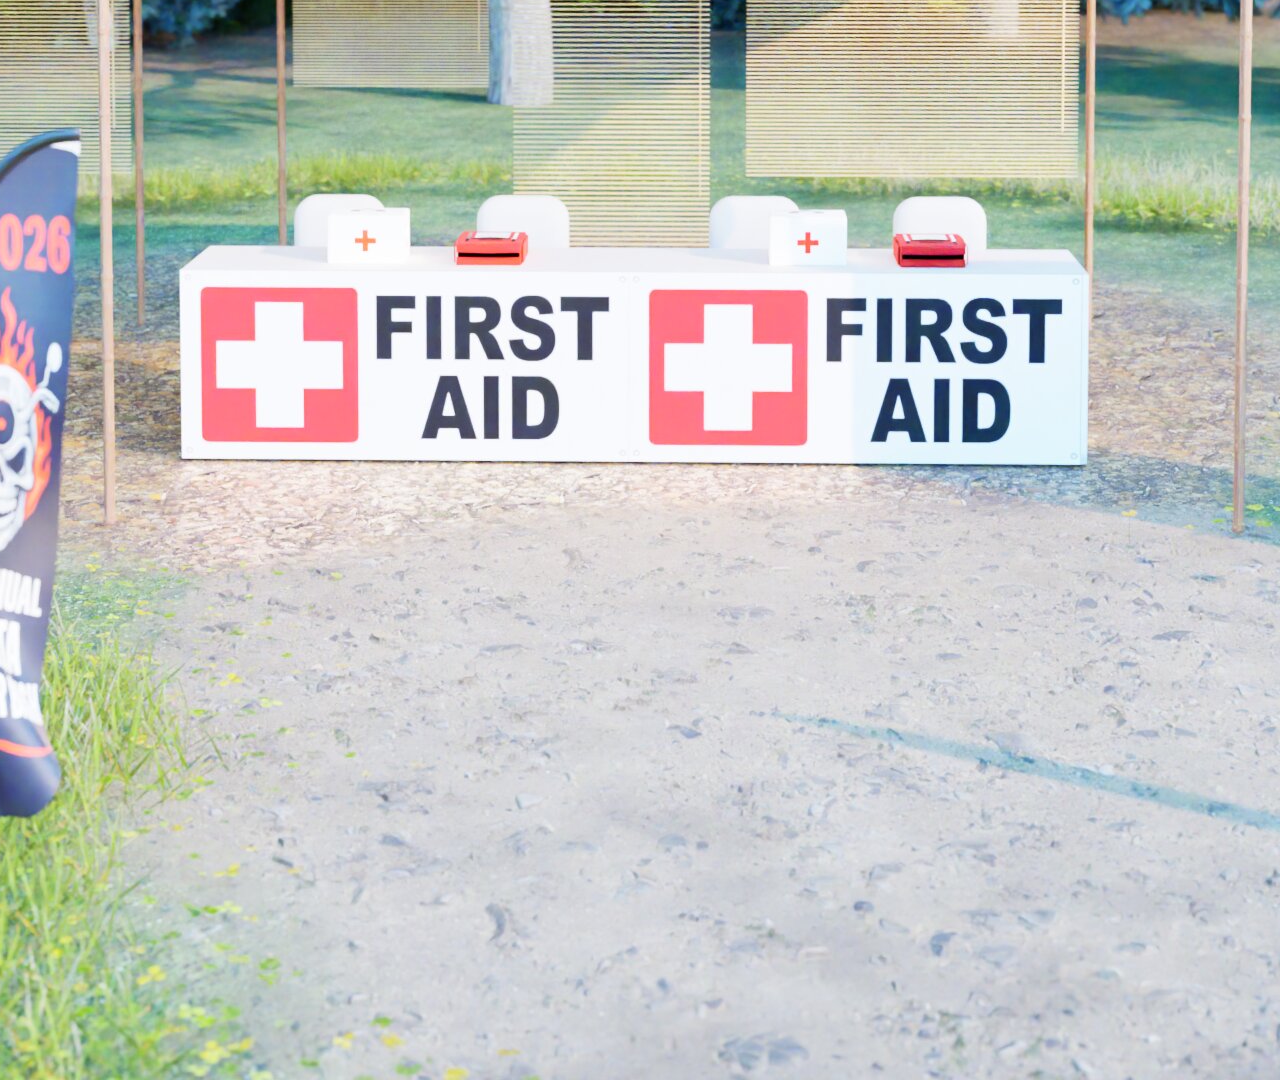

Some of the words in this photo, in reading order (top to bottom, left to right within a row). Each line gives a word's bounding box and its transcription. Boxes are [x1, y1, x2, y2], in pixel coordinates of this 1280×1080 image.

[374, 294, 610, 362] FIRST
[825, 297, 1064, 365] FIRST
[420, 374, 561, 441] AID
[869, 377, 1012, 444] AID
